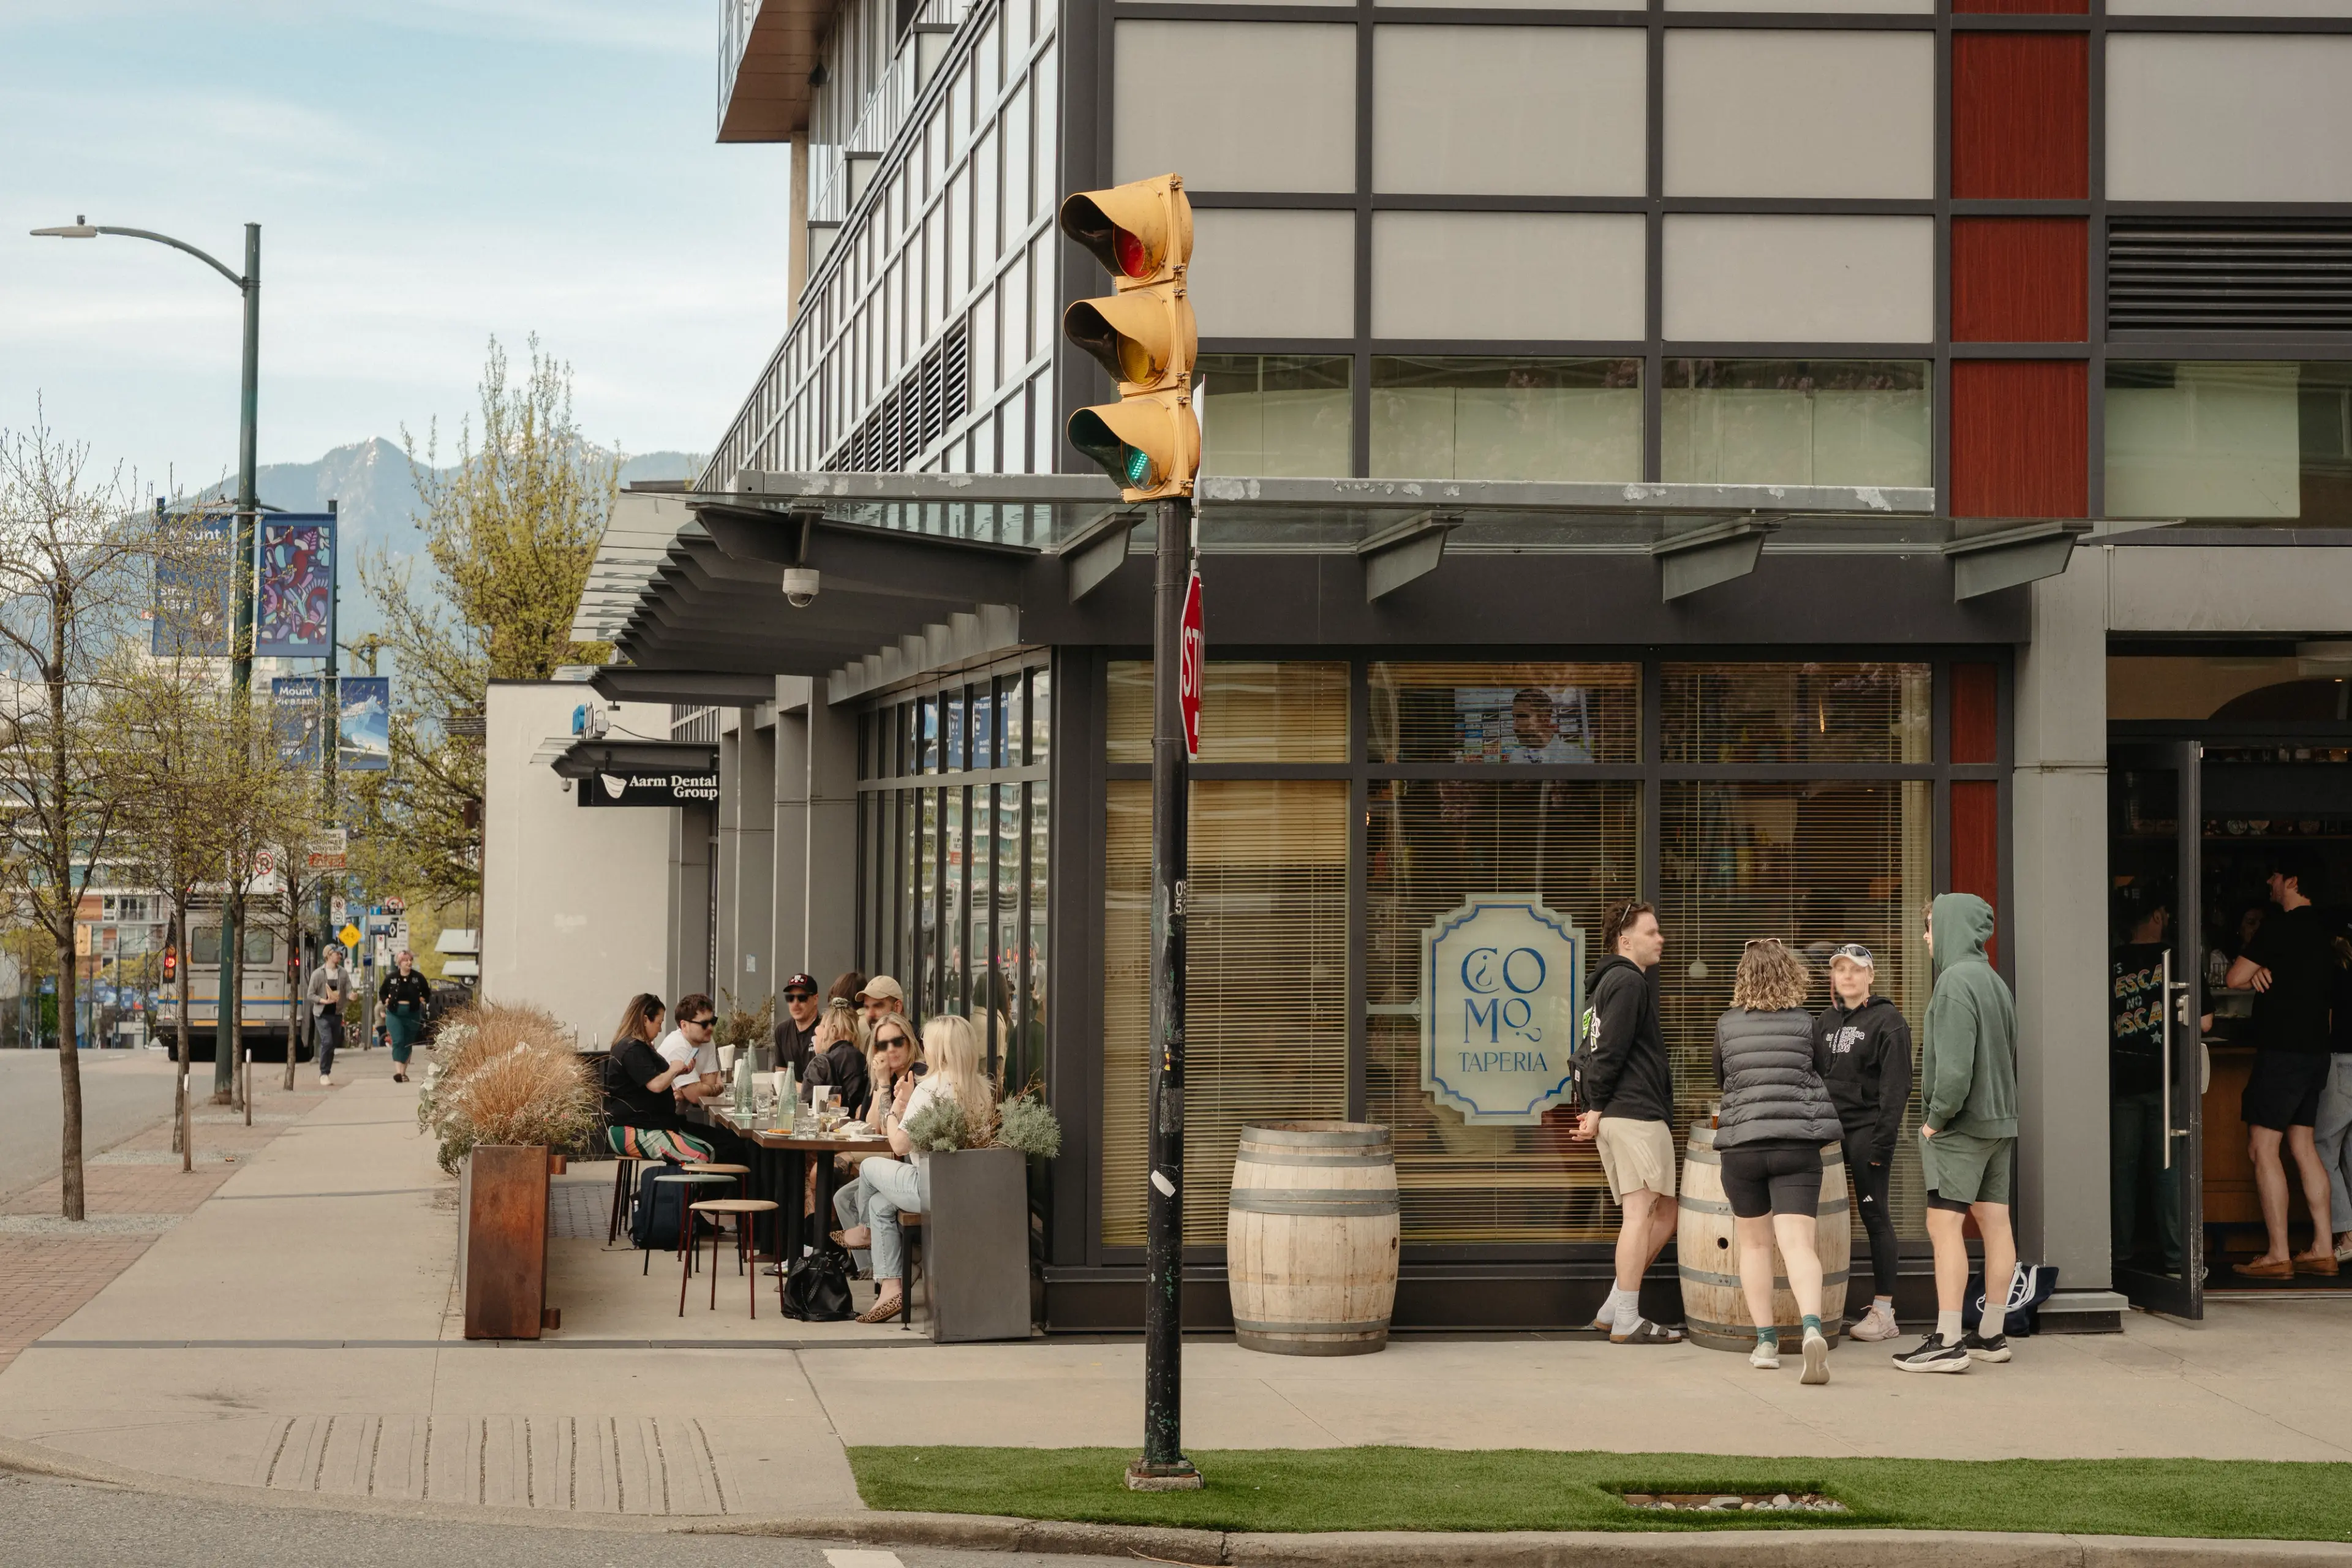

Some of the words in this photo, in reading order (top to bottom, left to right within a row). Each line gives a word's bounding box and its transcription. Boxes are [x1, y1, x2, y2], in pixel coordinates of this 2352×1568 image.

[279, 687, 313, 696] Mount
[629, 775, 667, 787] Aarm
[671, 775, 717, 787] Dental
[673, 786, 718, 801] Group
[2126, 995, 2143, 1011] NO
[1458, 1051, 1548, 1072] TAPERIA
